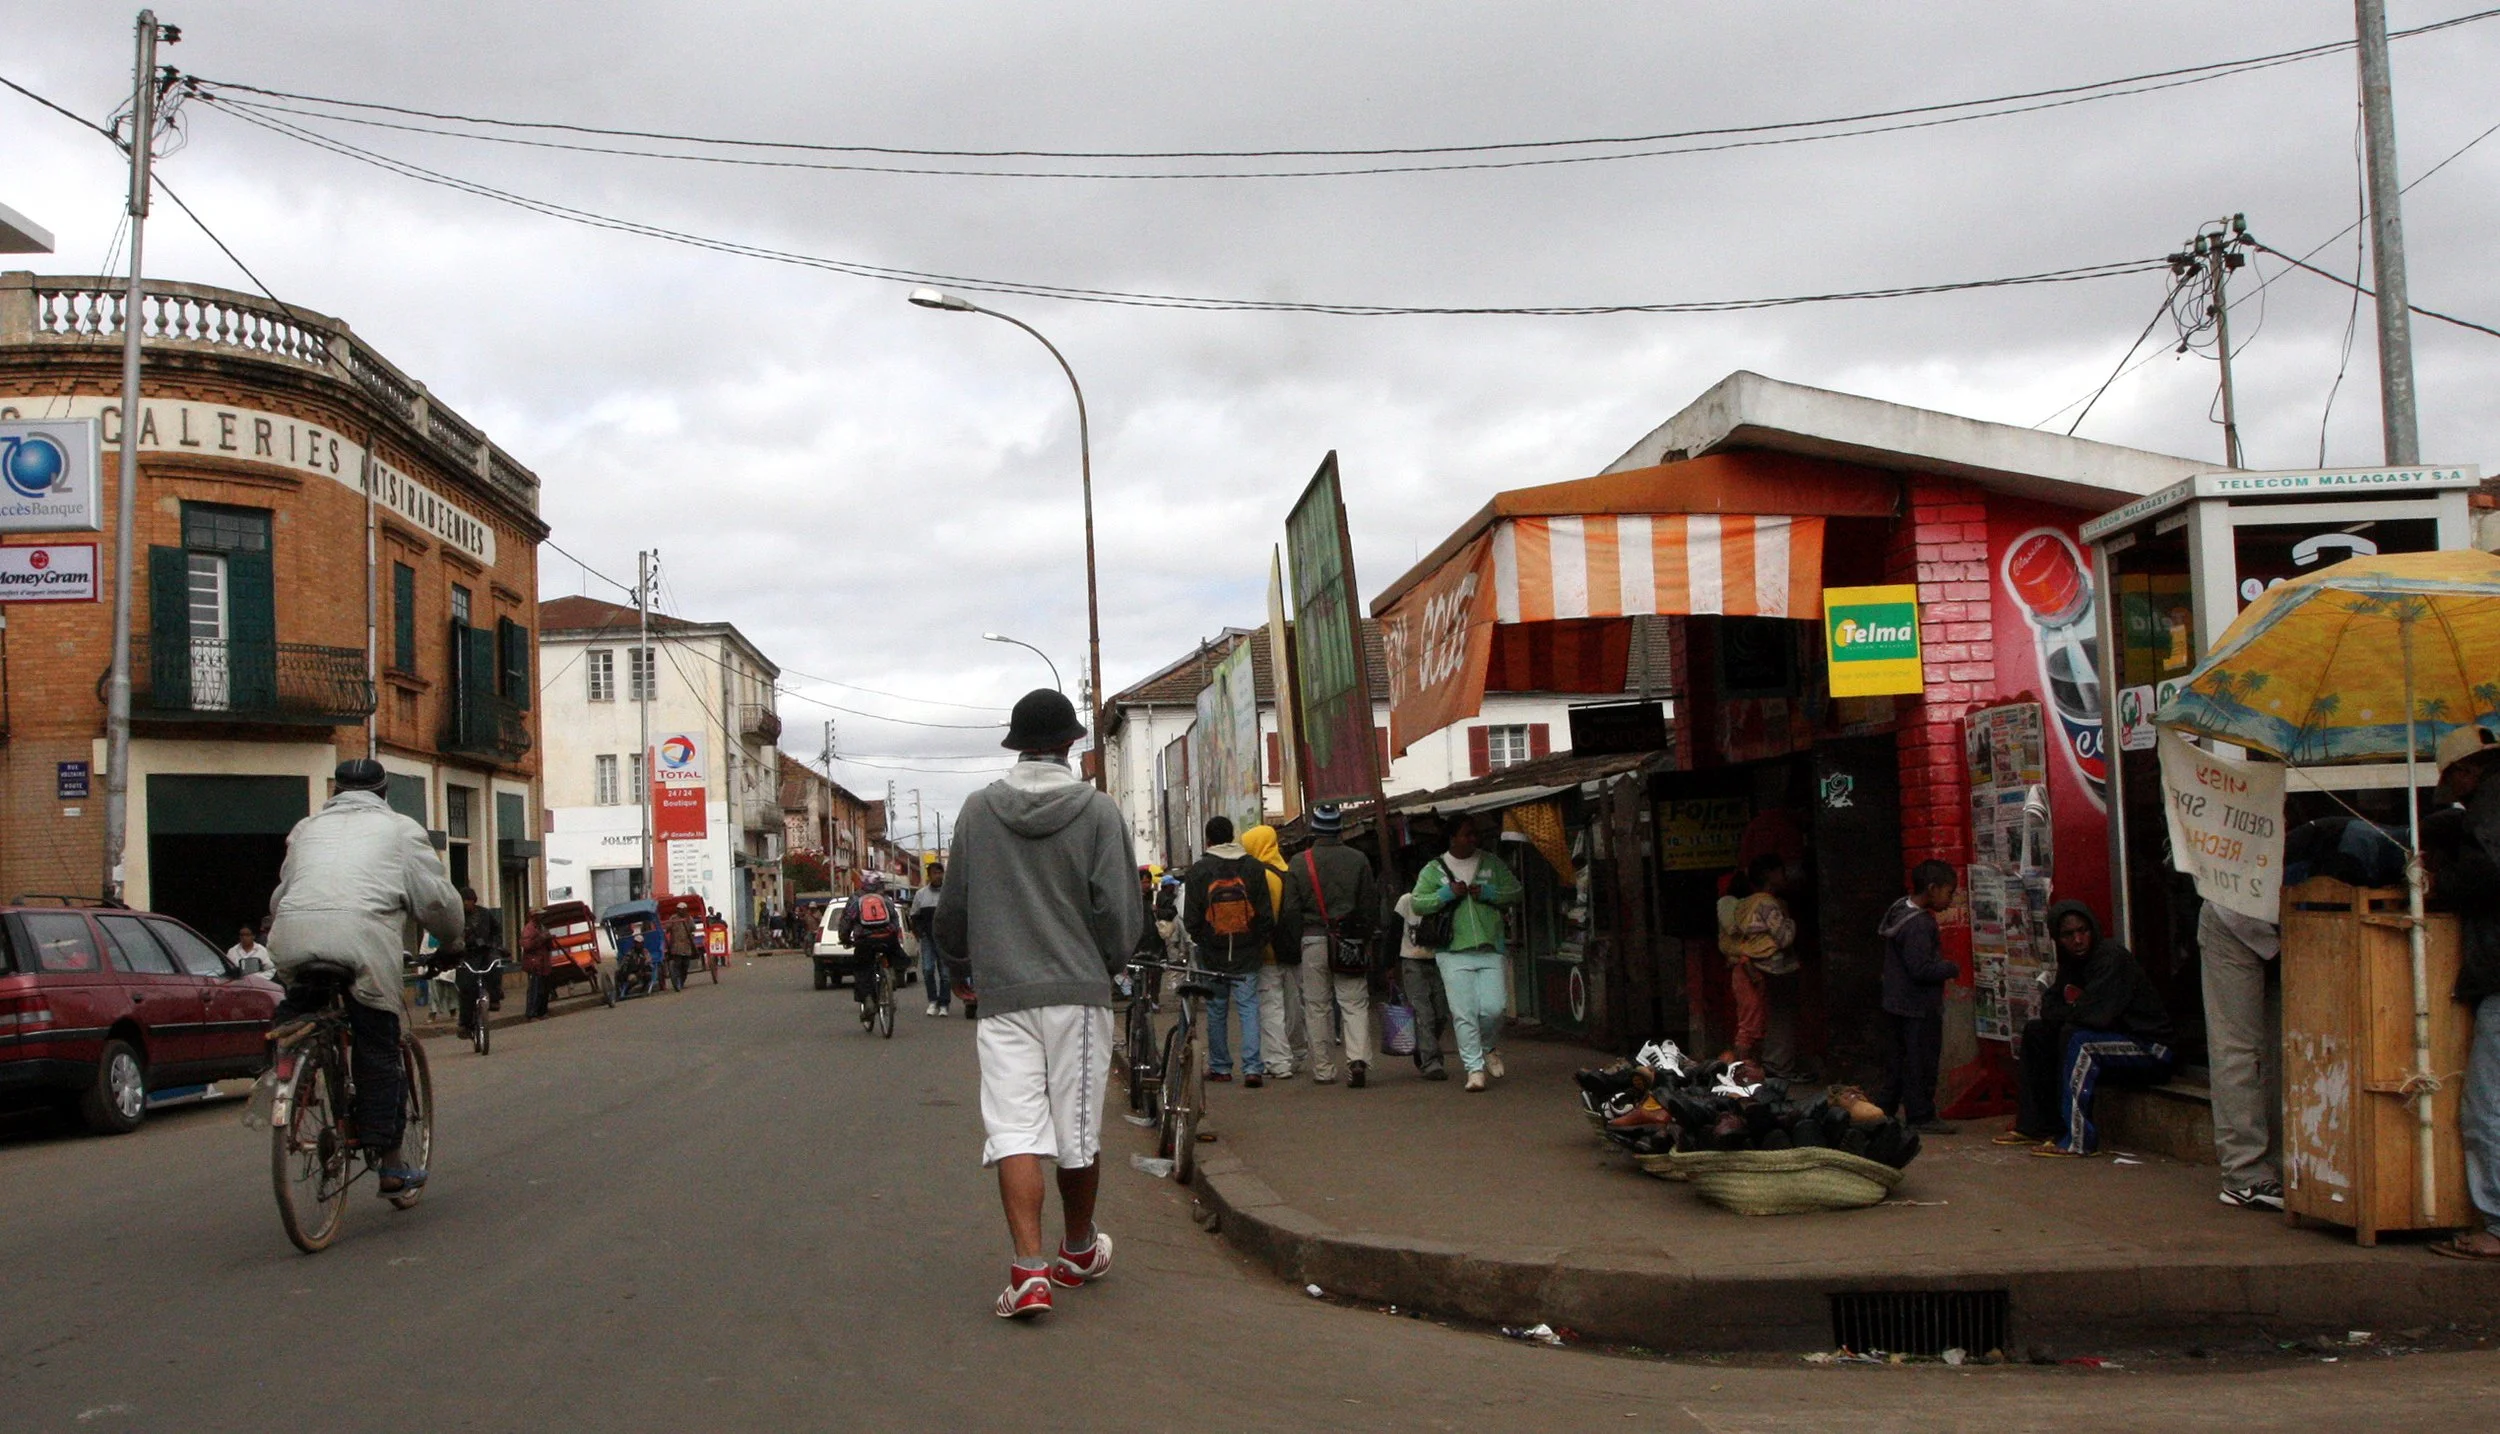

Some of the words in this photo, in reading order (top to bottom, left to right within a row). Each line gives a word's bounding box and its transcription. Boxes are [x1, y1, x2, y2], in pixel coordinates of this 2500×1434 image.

[101, 405, 339, 474] GALERIES
[2218, 477, 2308, 490] TELECOM
[2319, 471, 2423, 486] MALAGASY
[0, 502, 84, 518] ccèsBanque
[1842, 622, 1912, 643] Telma
[657, 769, 703, 779] TOTAL
[663, 799, 698, 808] Boutique
